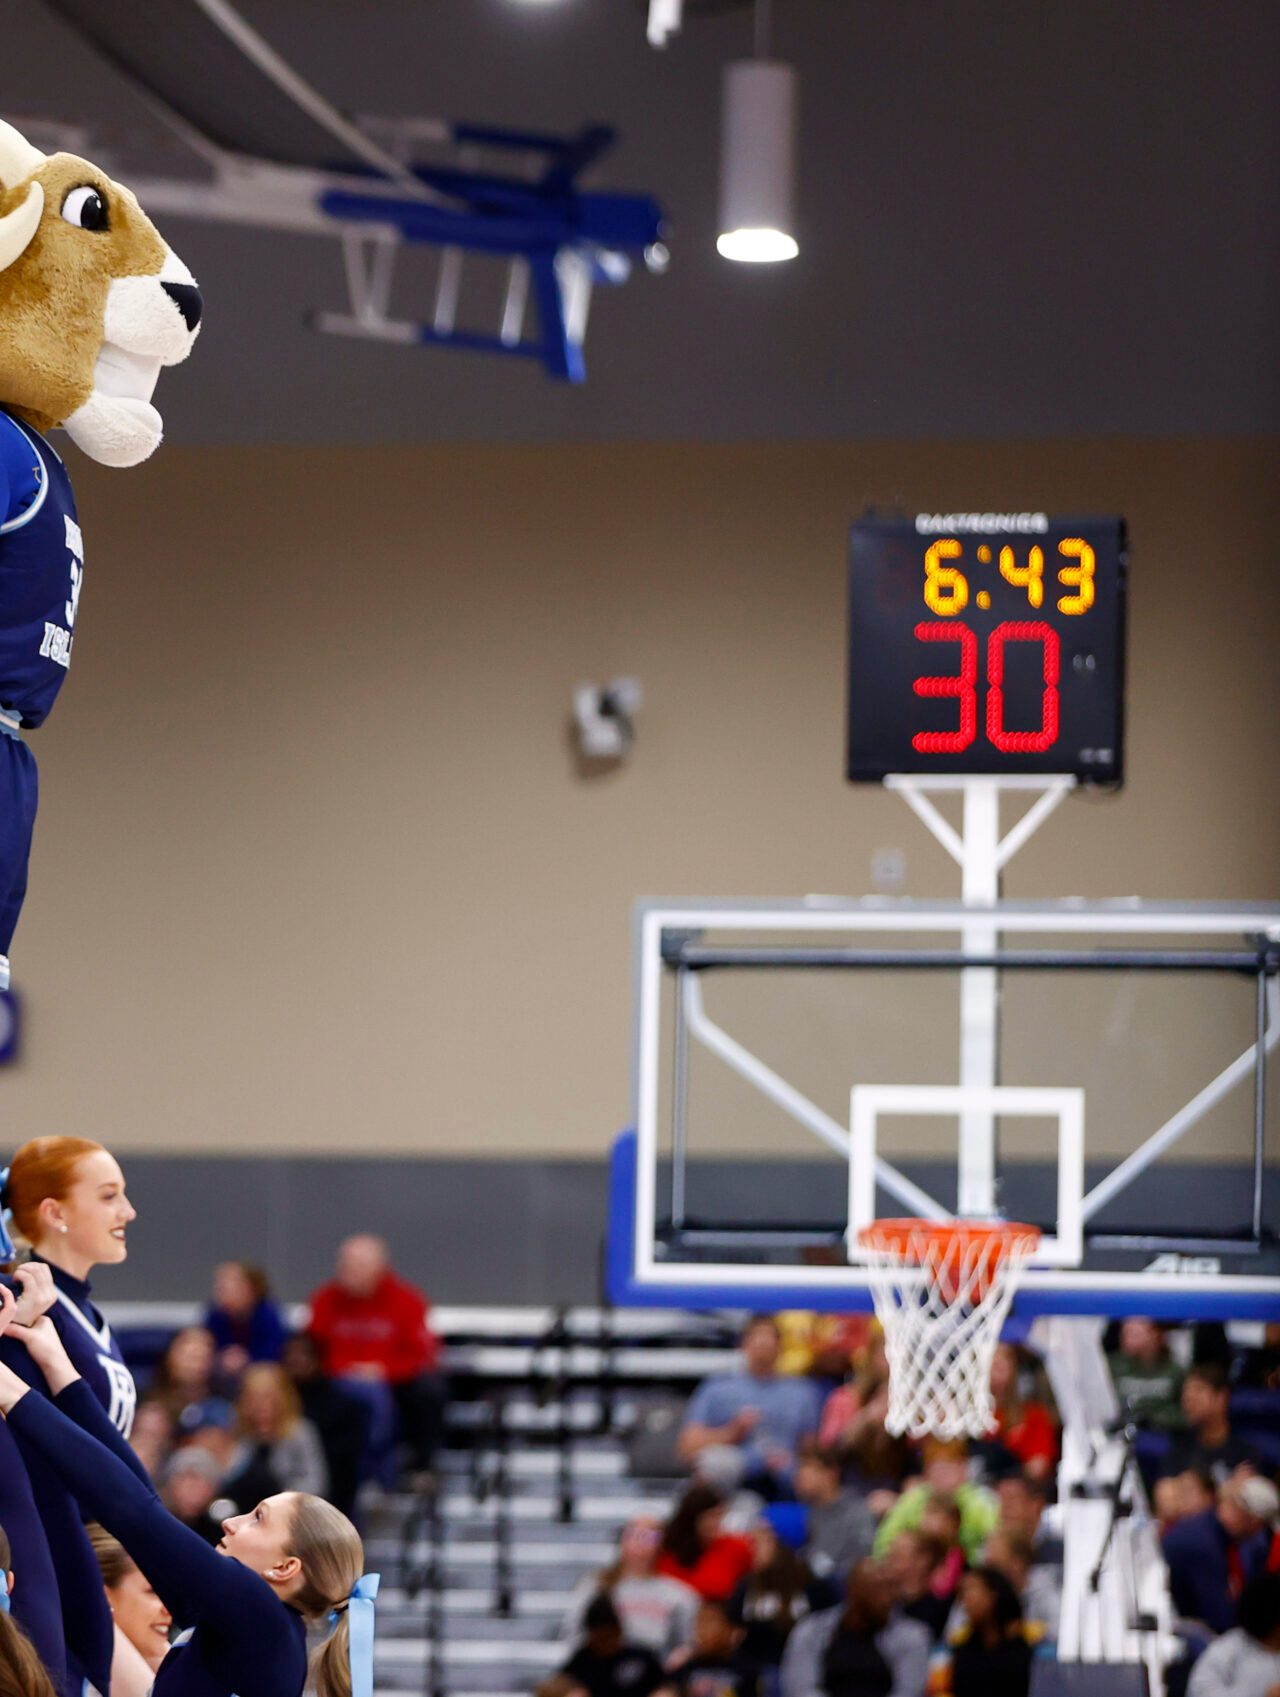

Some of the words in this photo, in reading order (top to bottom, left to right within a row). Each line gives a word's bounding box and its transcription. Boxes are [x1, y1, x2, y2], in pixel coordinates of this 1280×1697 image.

[924, 537, 1096, 616] 6:43
[39, 621, 74, 669] ISL
[912, 620, 1061, 753] 30
